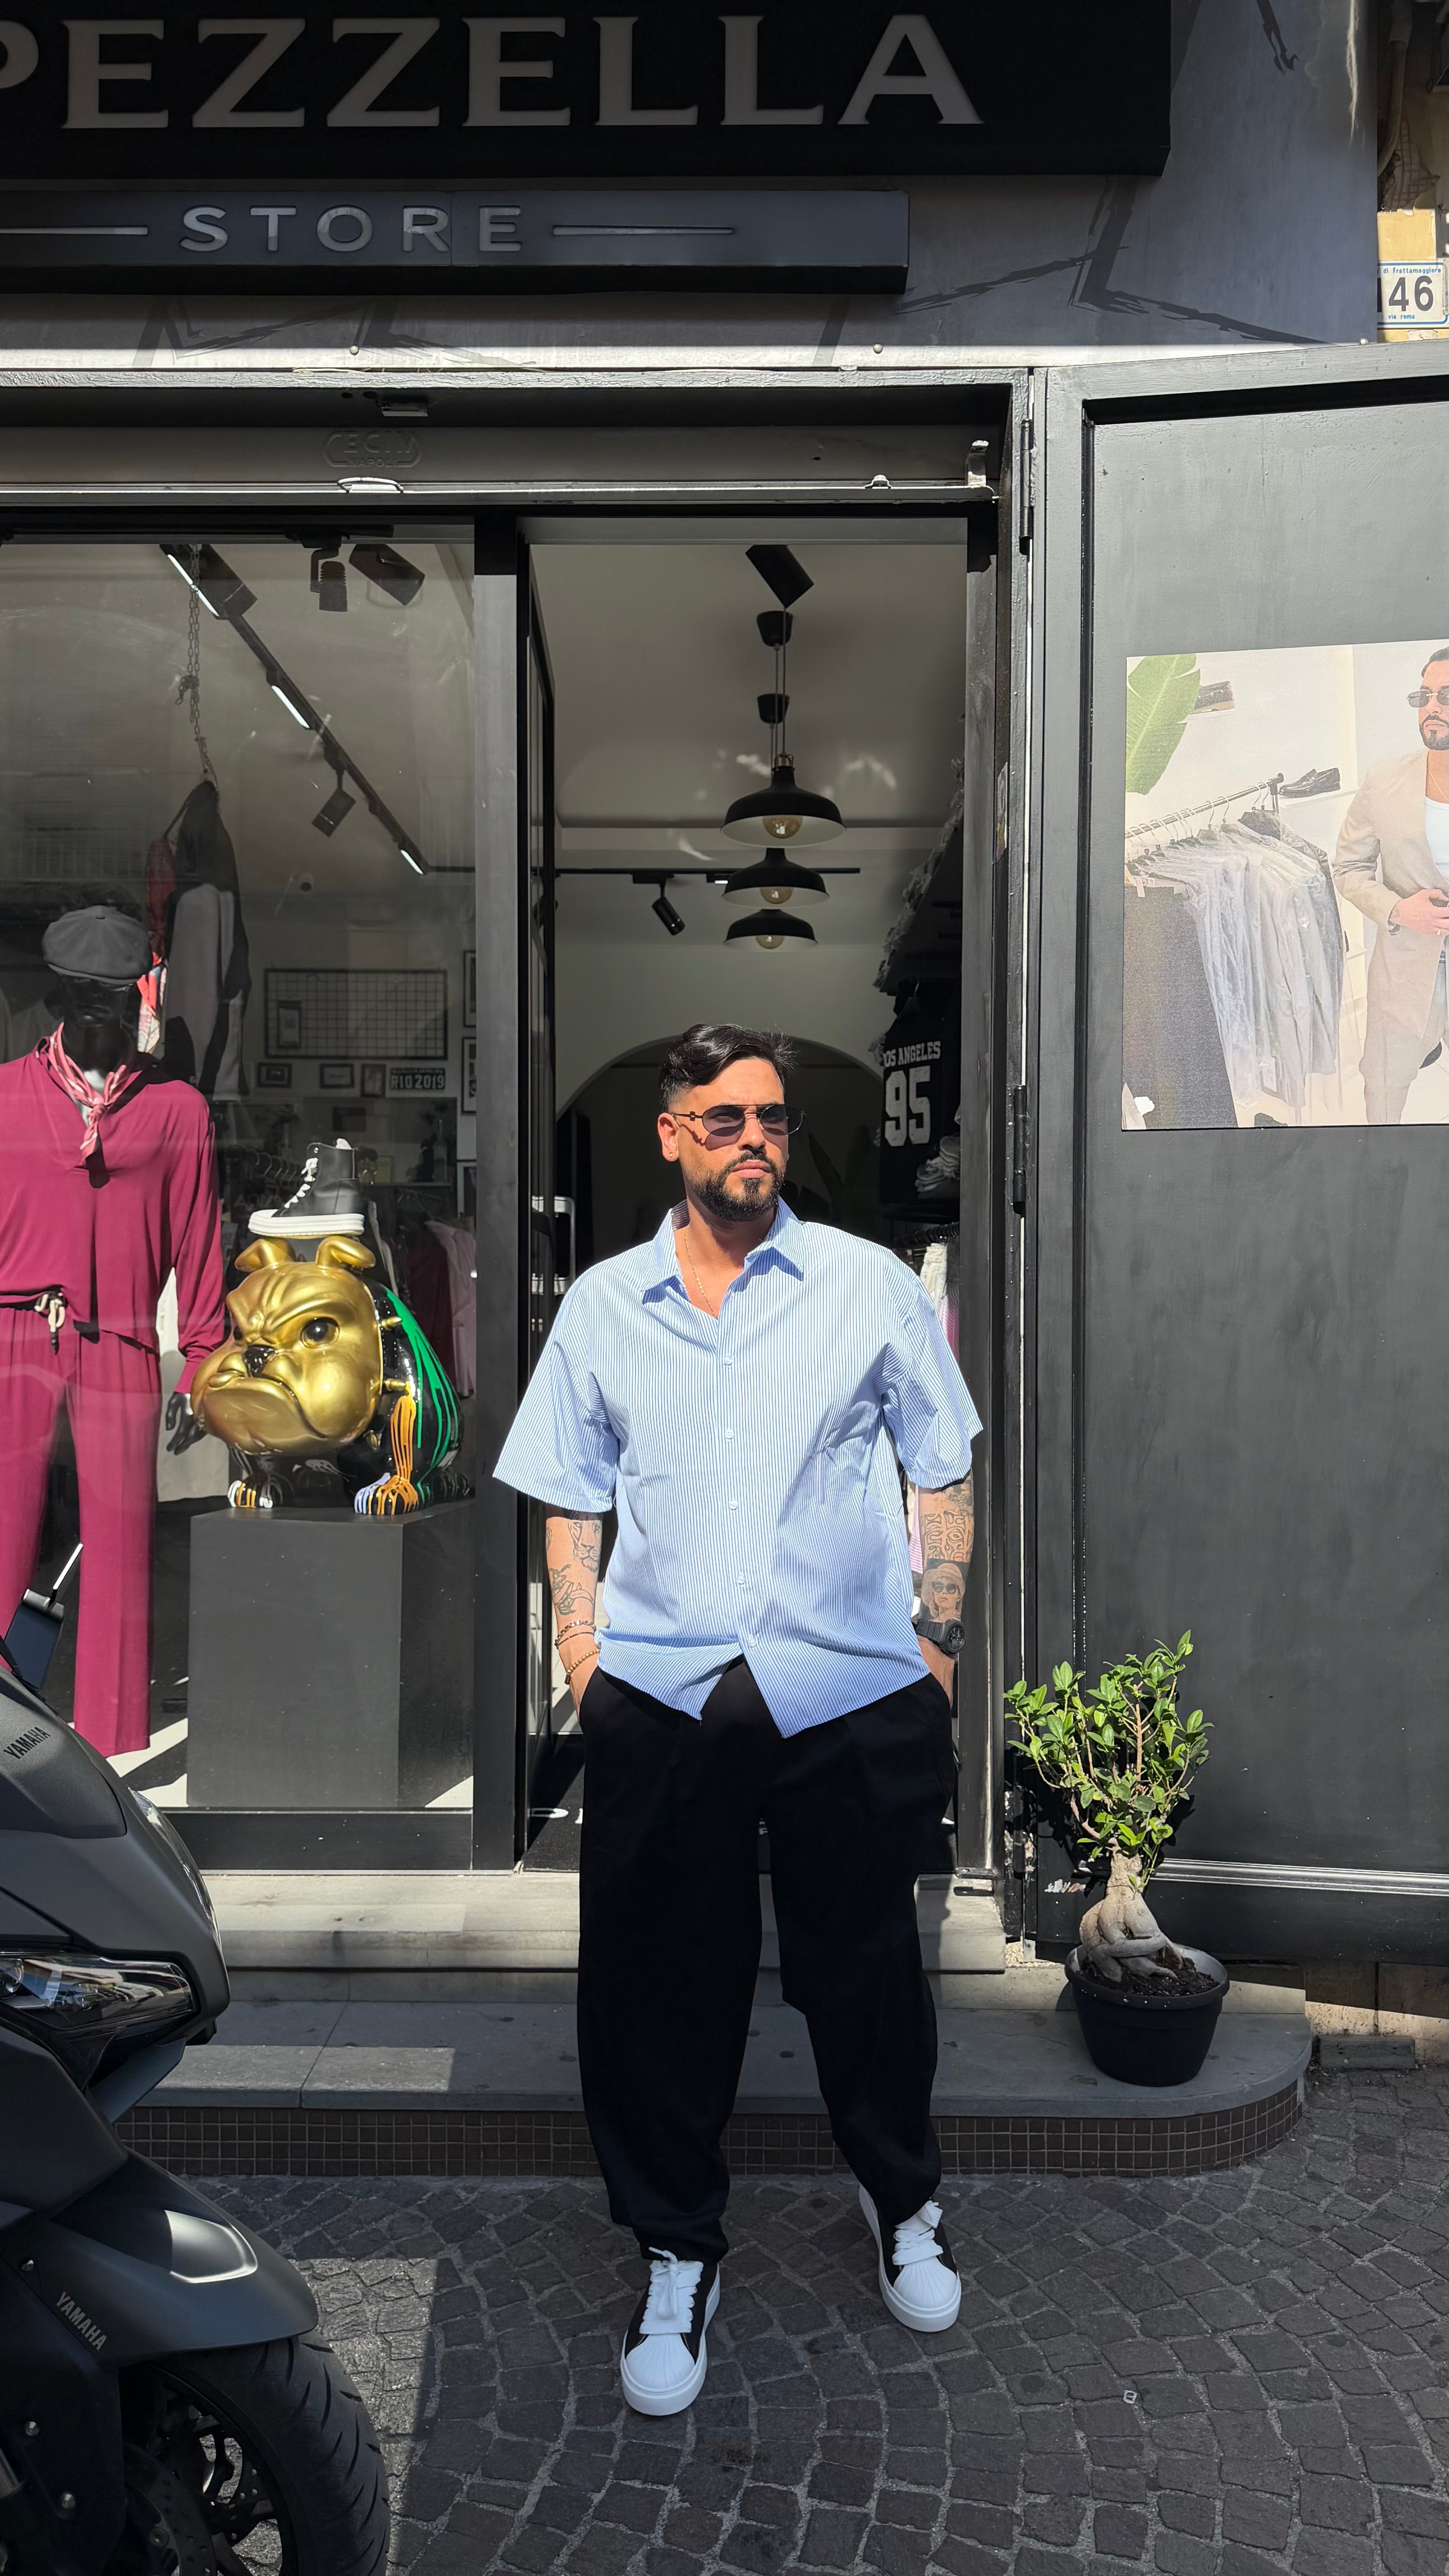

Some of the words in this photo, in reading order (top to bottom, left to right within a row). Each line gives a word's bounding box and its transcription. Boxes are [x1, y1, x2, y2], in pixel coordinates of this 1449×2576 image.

[180, 205, 522, 252] STORE
[898, 1040, 941, 1066] ANGELES
[884, 1065, 931, 1147] 95
[3, 1726, 51, 1760] YAMAHA
[56, 2291, 107, 2351] YAMAHA
